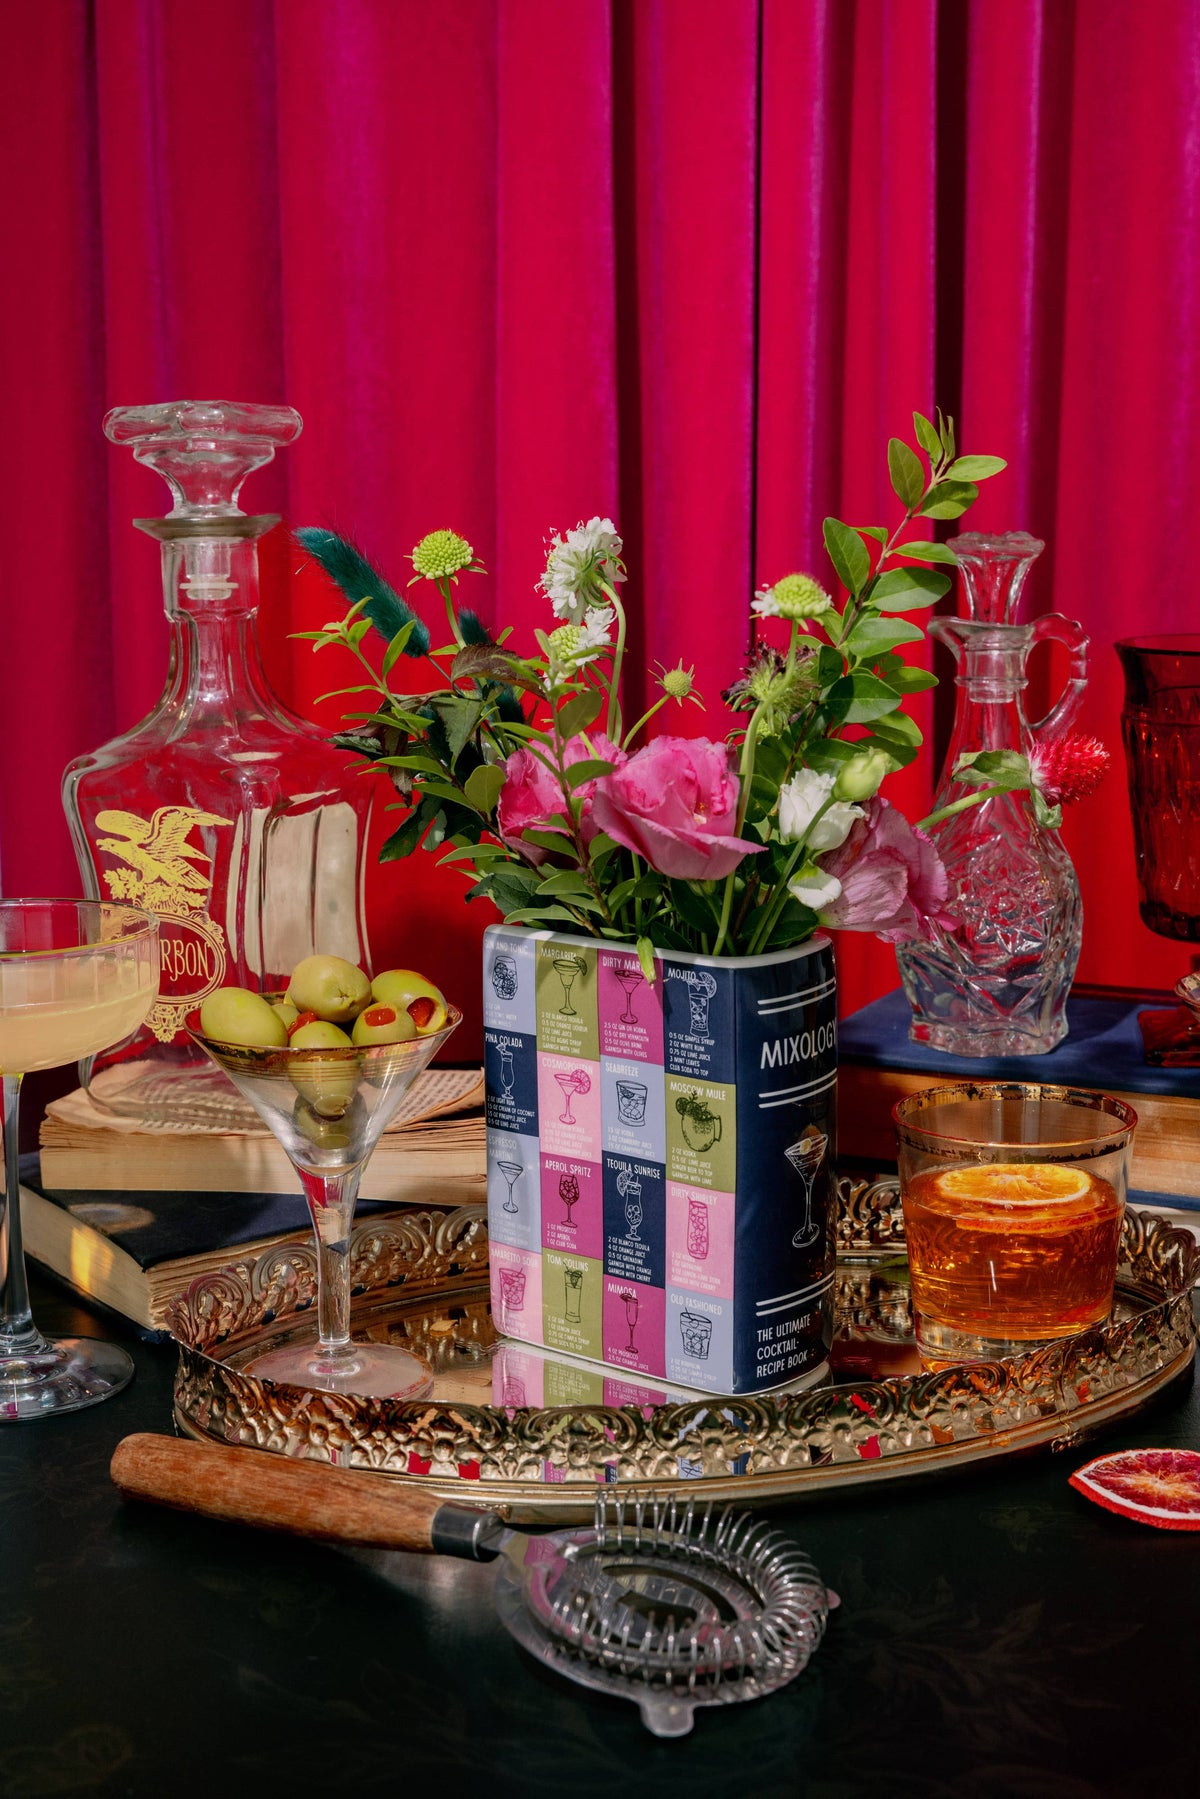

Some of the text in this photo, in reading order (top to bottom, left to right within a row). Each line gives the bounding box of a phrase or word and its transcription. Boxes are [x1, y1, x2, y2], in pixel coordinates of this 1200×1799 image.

[602, 956, 622, 968] DIRTY
[668, 968, 696, 981] MOJITO
[485, 1033, 523, 1048] PINA COLADA
[760, 1017, 837, 1069] MIXOLOGY
[542, 1058, 593, 1073] COSMOPOLITAN
[605, 1062, 639, 1077] SEABREEZE
[670, 1082, 727, 1100] MOSCOW MULE
[545, 1160, 591, 1178] APEROL SPRITZ
[607, 1159, 660, 1179] TEQUILA SUNRISE
[672, 1187, 718, 1205] DIRTY SHIRLEY
[547, 1254, 589, 1272] TOM COLLINS
[608, 1283, 637, 1298] MIMOSA
[671, 1294, 722, 1315] OLD FASHIONED
[757, 1314, 810, 1342] THE ULTIMATE
[757, 1338, 797, 1360] COCKTAIL
[757, 1350, 808, 1378] RECIPE BOOK
